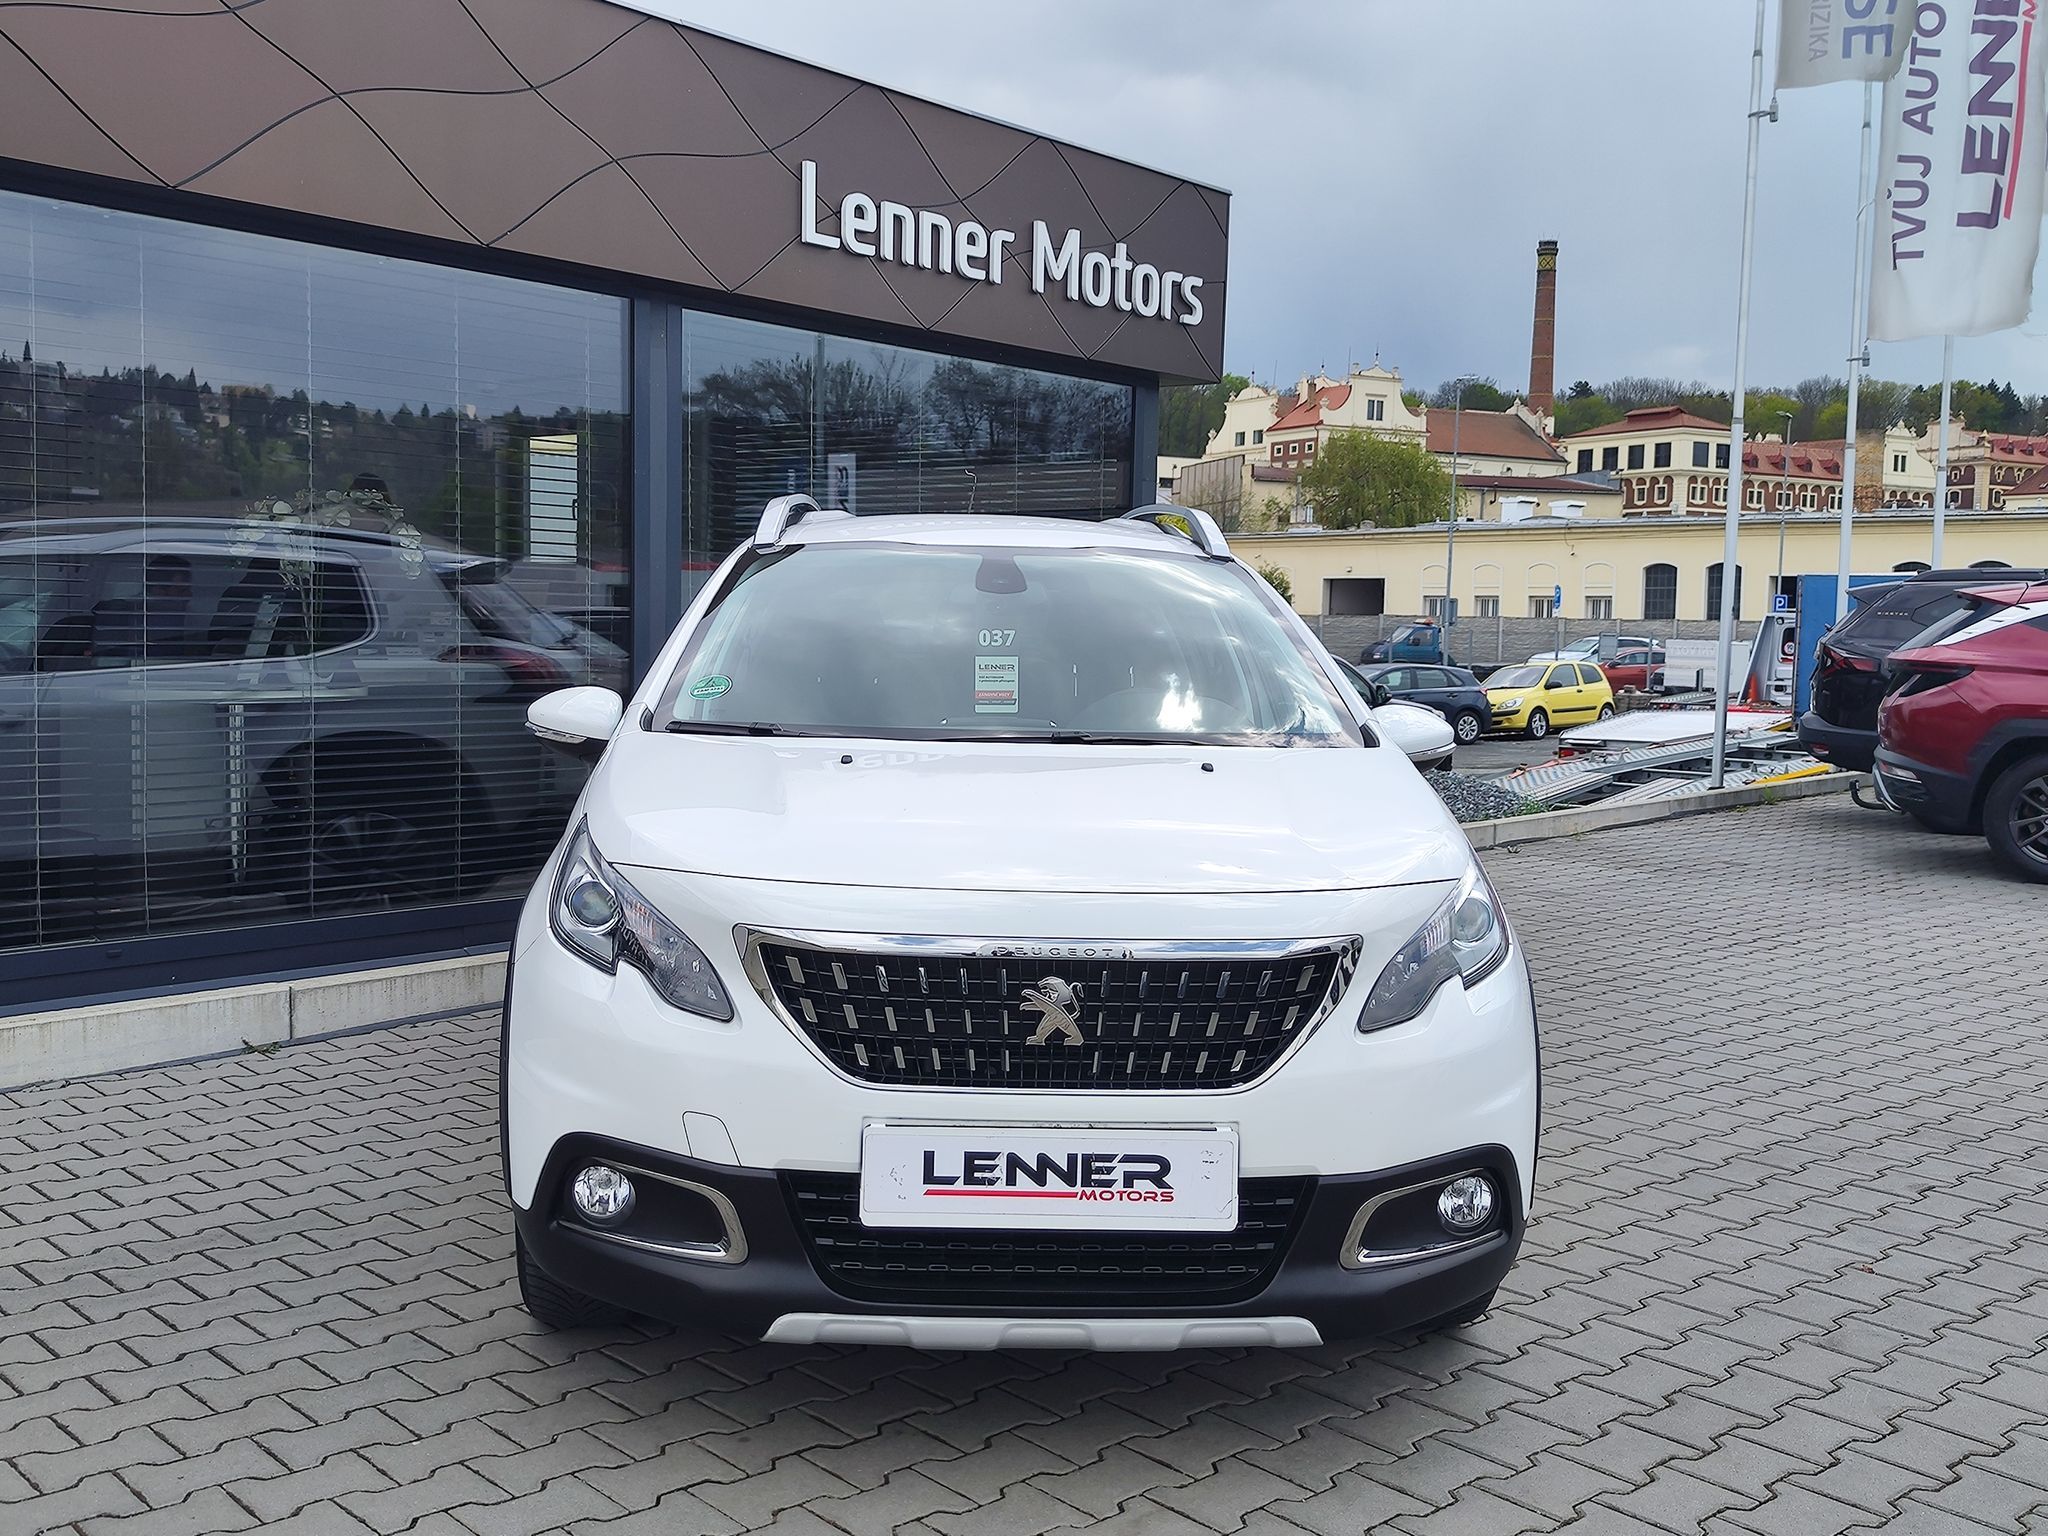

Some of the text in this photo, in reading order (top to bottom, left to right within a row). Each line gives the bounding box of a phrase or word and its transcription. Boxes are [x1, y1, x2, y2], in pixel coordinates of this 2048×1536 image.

[800, 159, 1204, 327] Lenner Motors
[978, 629, 1016, 647] 037
[978, 664, 1015, 672] LENNER
[996, 946, 1113, 957] PEUGEOT
[922, 1150, 1175, 1190] LENNER
[1079, 1189, 1175, 1203] MOTORS
